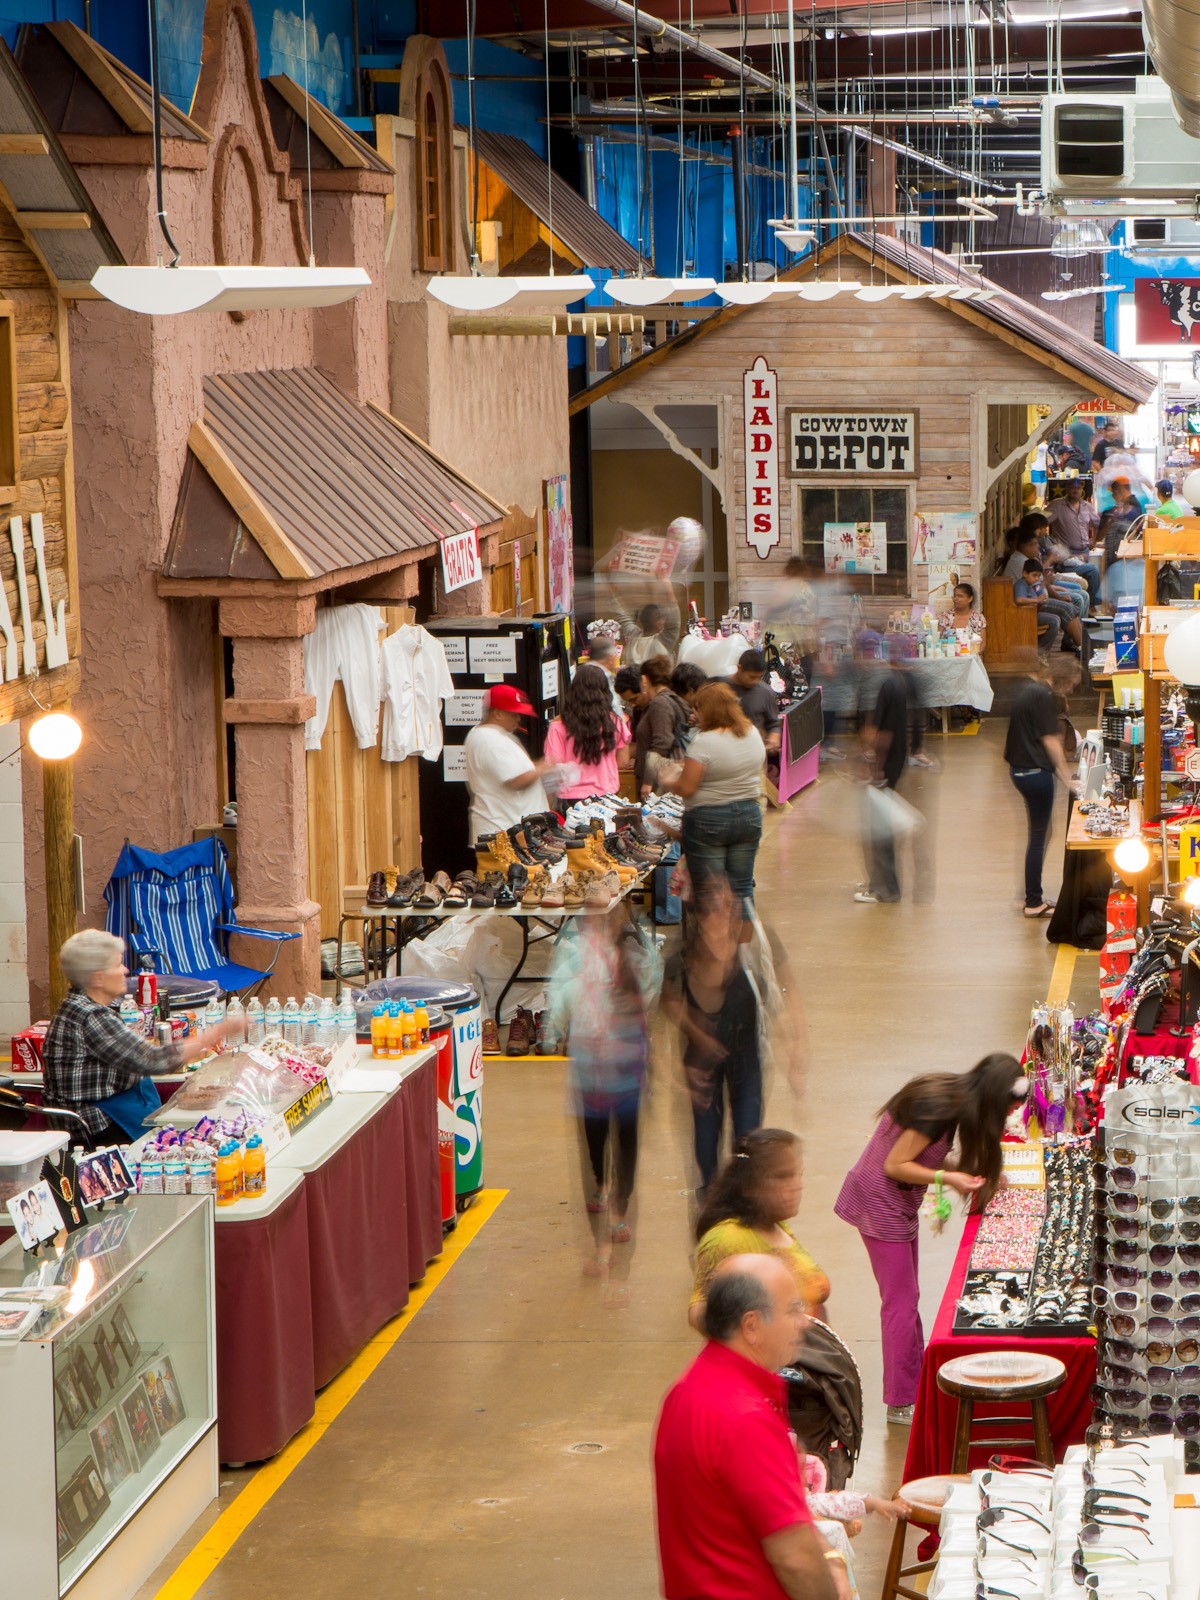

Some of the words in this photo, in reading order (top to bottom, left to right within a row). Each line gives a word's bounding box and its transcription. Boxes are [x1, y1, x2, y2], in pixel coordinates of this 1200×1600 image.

[800, 418, 908, 433] COWTOWN
[749, 379, 774, 533] LADIES
[795, 435, 910, 470] DEPOT
[446, 536, 475, 587] GRATIS
[930, 565, 959, 574] JAFRA
[1190, 761, 1198, 770] E
[284, 1100, 305, 1130] FREE
[302, 1079, 330, 1116] SAMPLE
